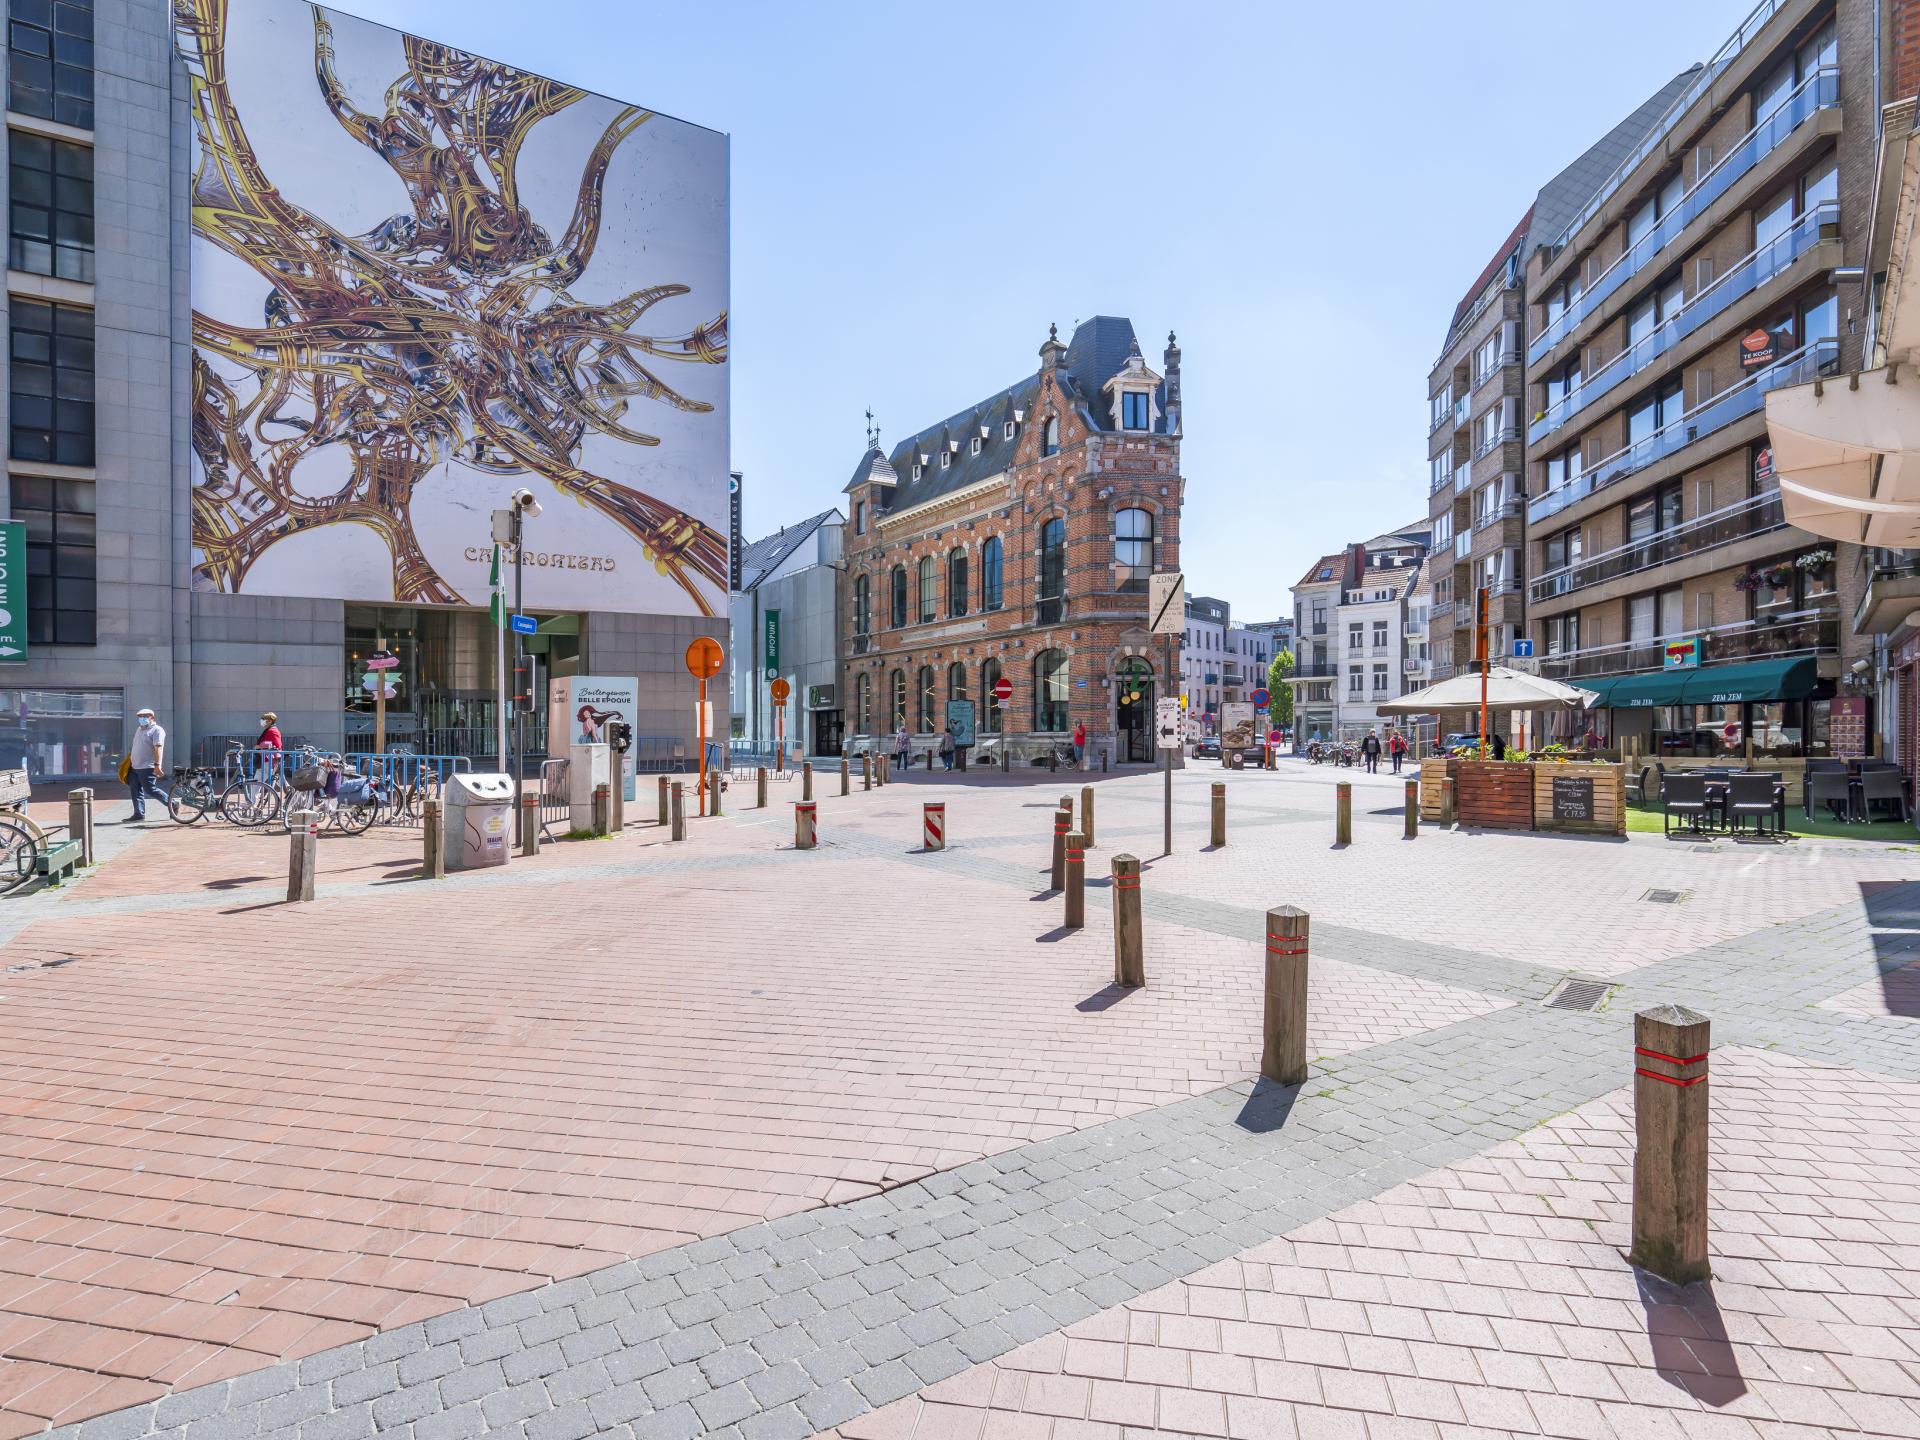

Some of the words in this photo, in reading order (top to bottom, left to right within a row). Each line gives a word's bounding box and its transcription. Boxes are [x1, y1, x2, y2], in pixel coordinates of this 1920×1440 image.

[1752, 348, 1773, 357] KOOP
[1156, 575, 1178, 584] ZONE
[1642, 698, 1653, 706] ZEM
[1712, 694, 1726, 702] ZEM
[1728, 693, 1742, 701] ZEM
